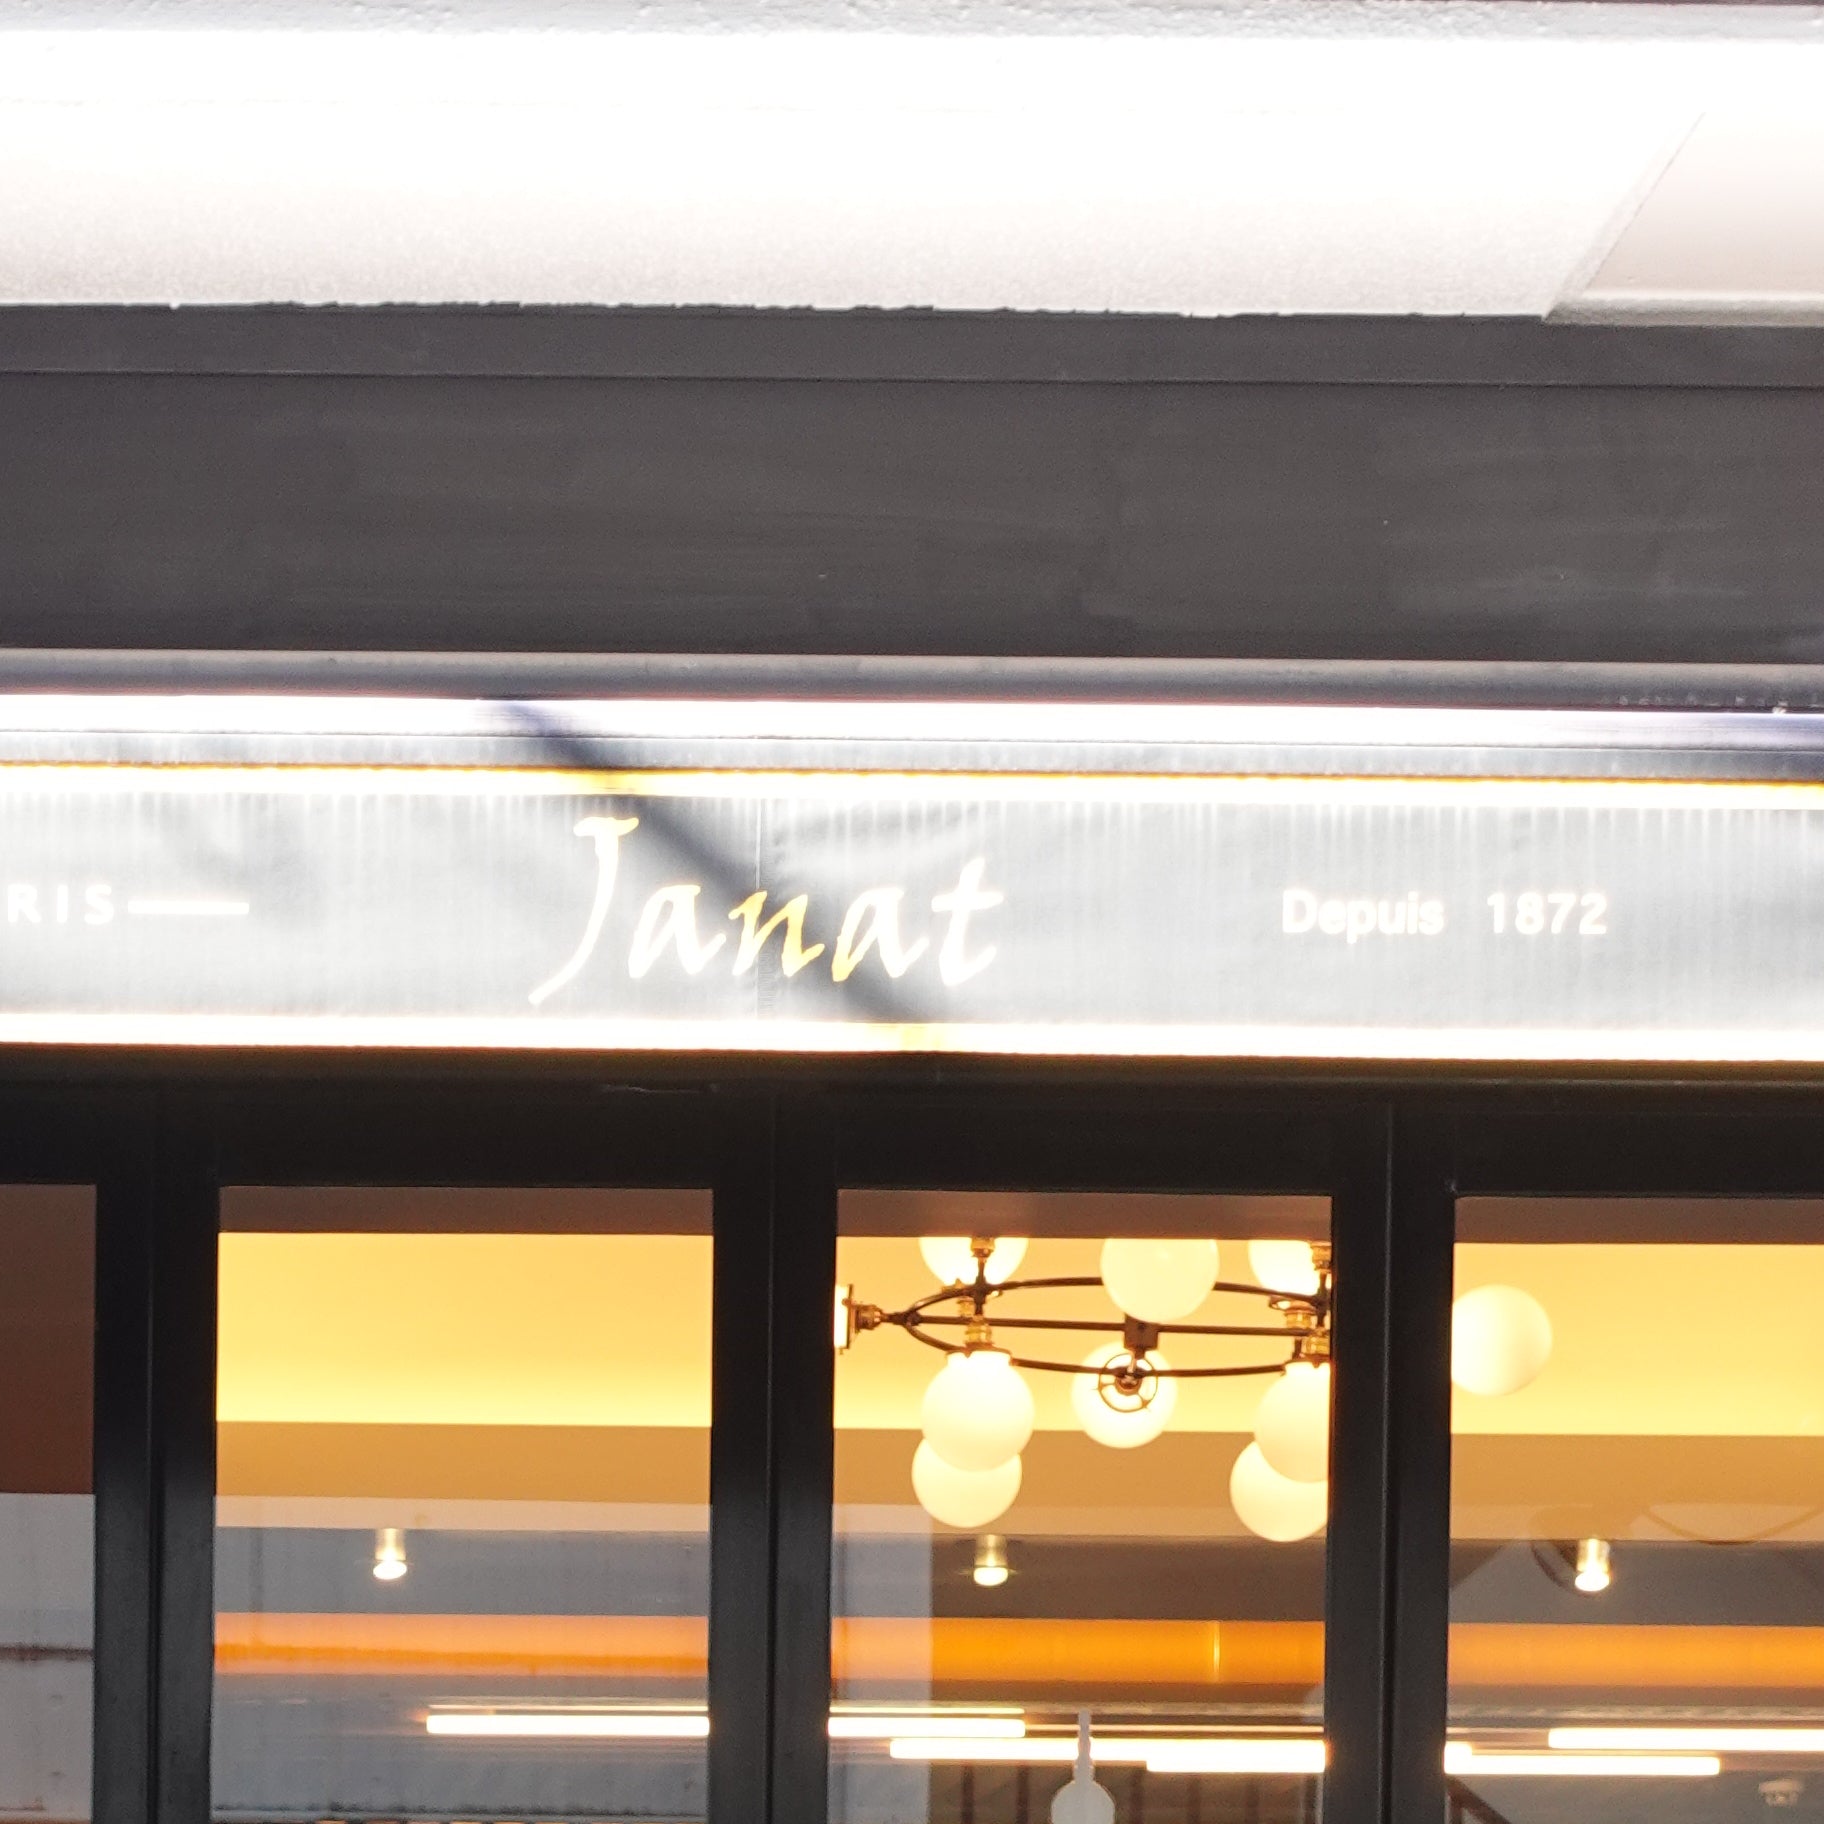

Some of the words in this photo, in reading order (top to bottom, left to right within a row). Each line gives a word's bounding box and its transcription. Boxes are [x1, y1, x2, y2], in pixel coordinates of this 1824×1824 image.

[528, 814, 1004, 1006] Janat
[1282, 889, 1445, 944] Depuis
[1486, 891, 1609, 936] 1872
